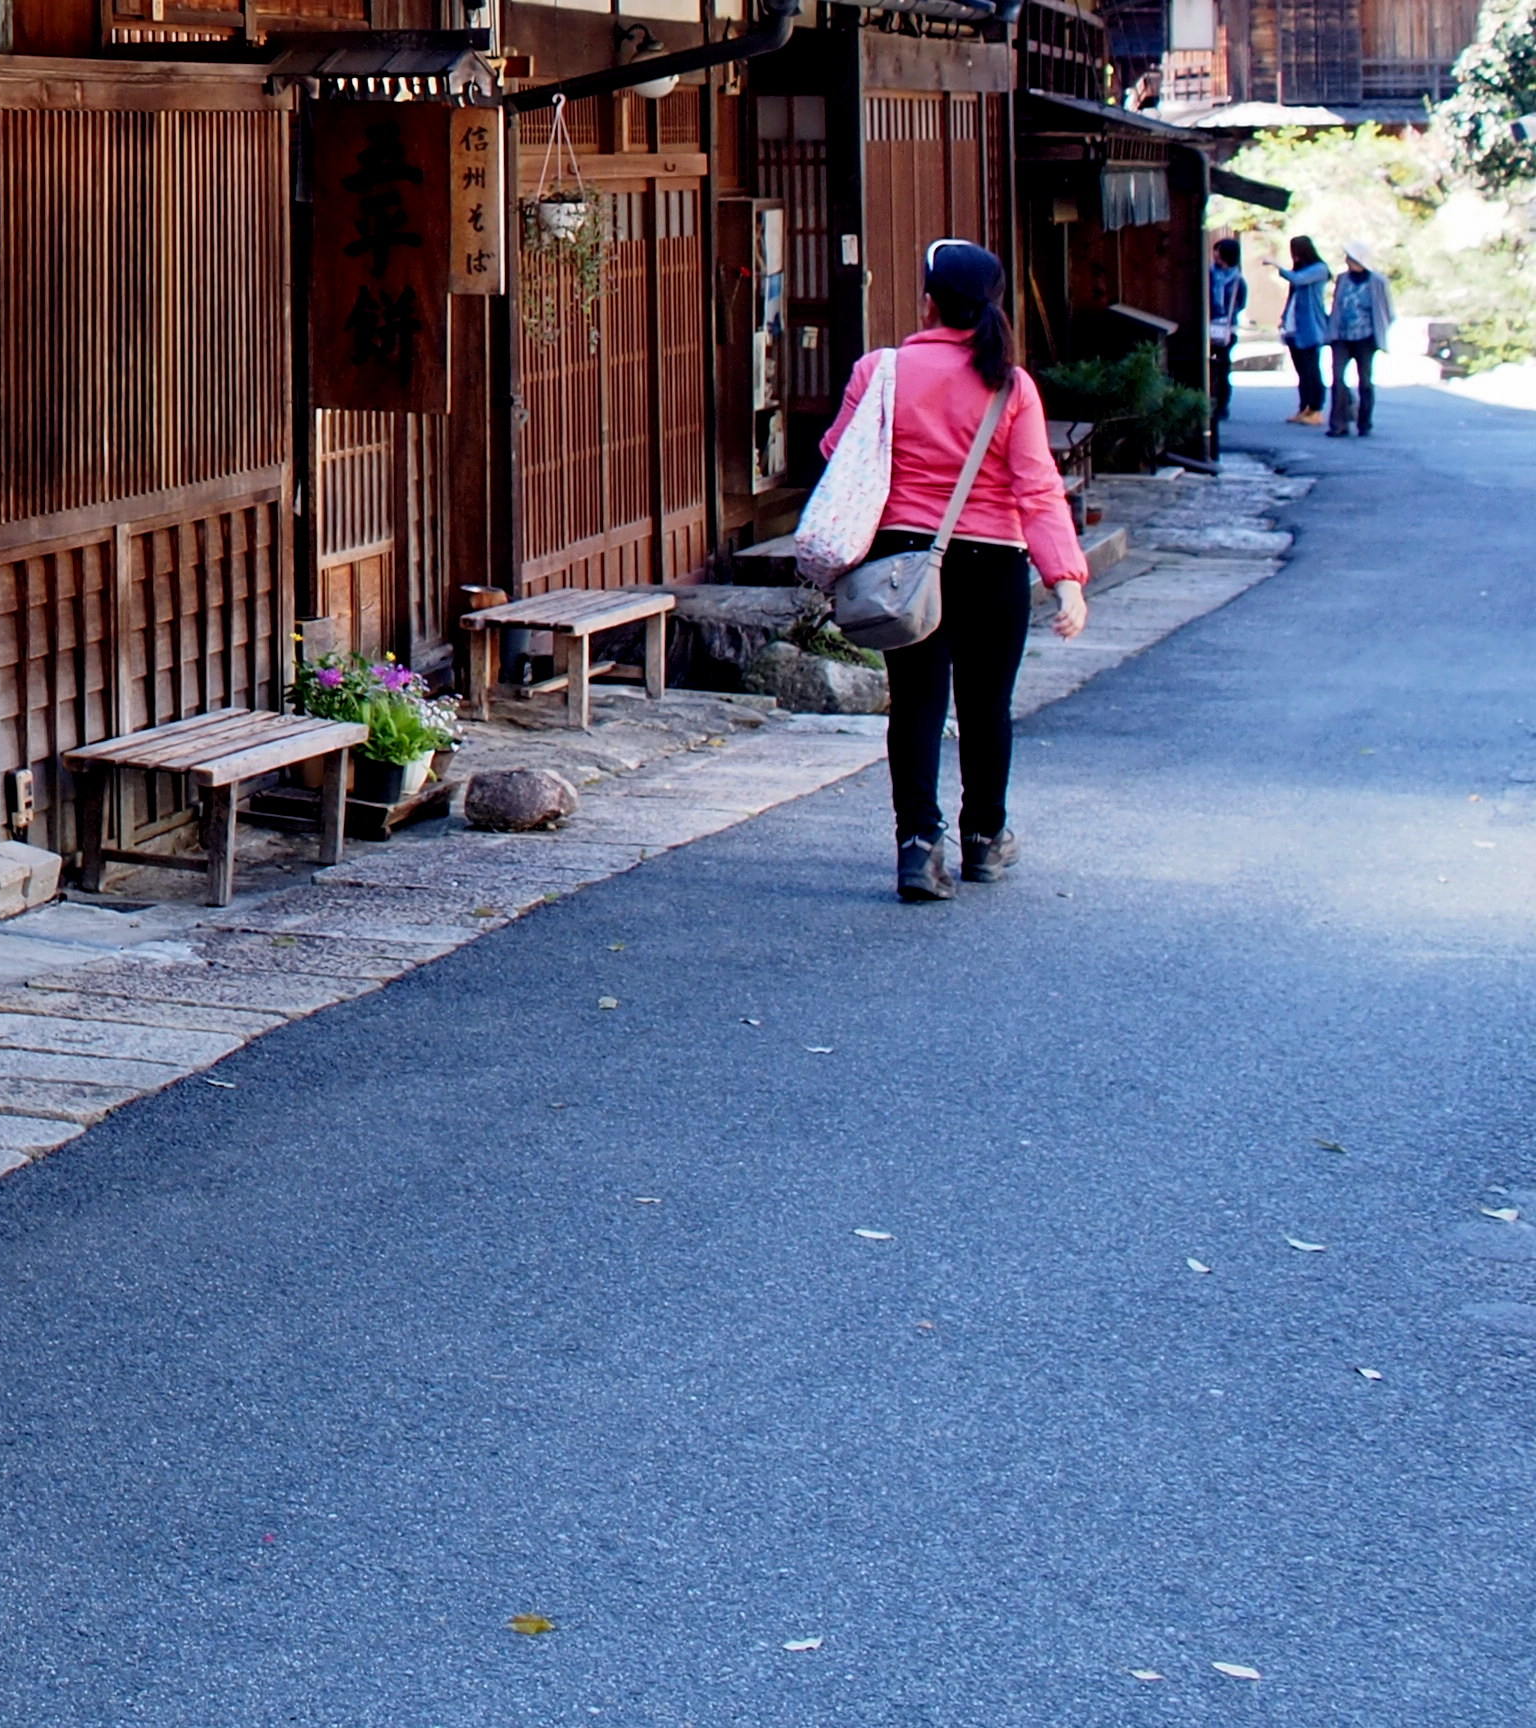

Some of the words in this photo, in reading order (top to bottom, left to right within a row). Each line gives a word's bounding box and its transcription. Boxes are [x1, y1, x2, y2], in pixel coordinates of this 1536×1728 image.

[341, 120, 423, 386] 五平餅
[460, 126, 494, 276] 信州そば
